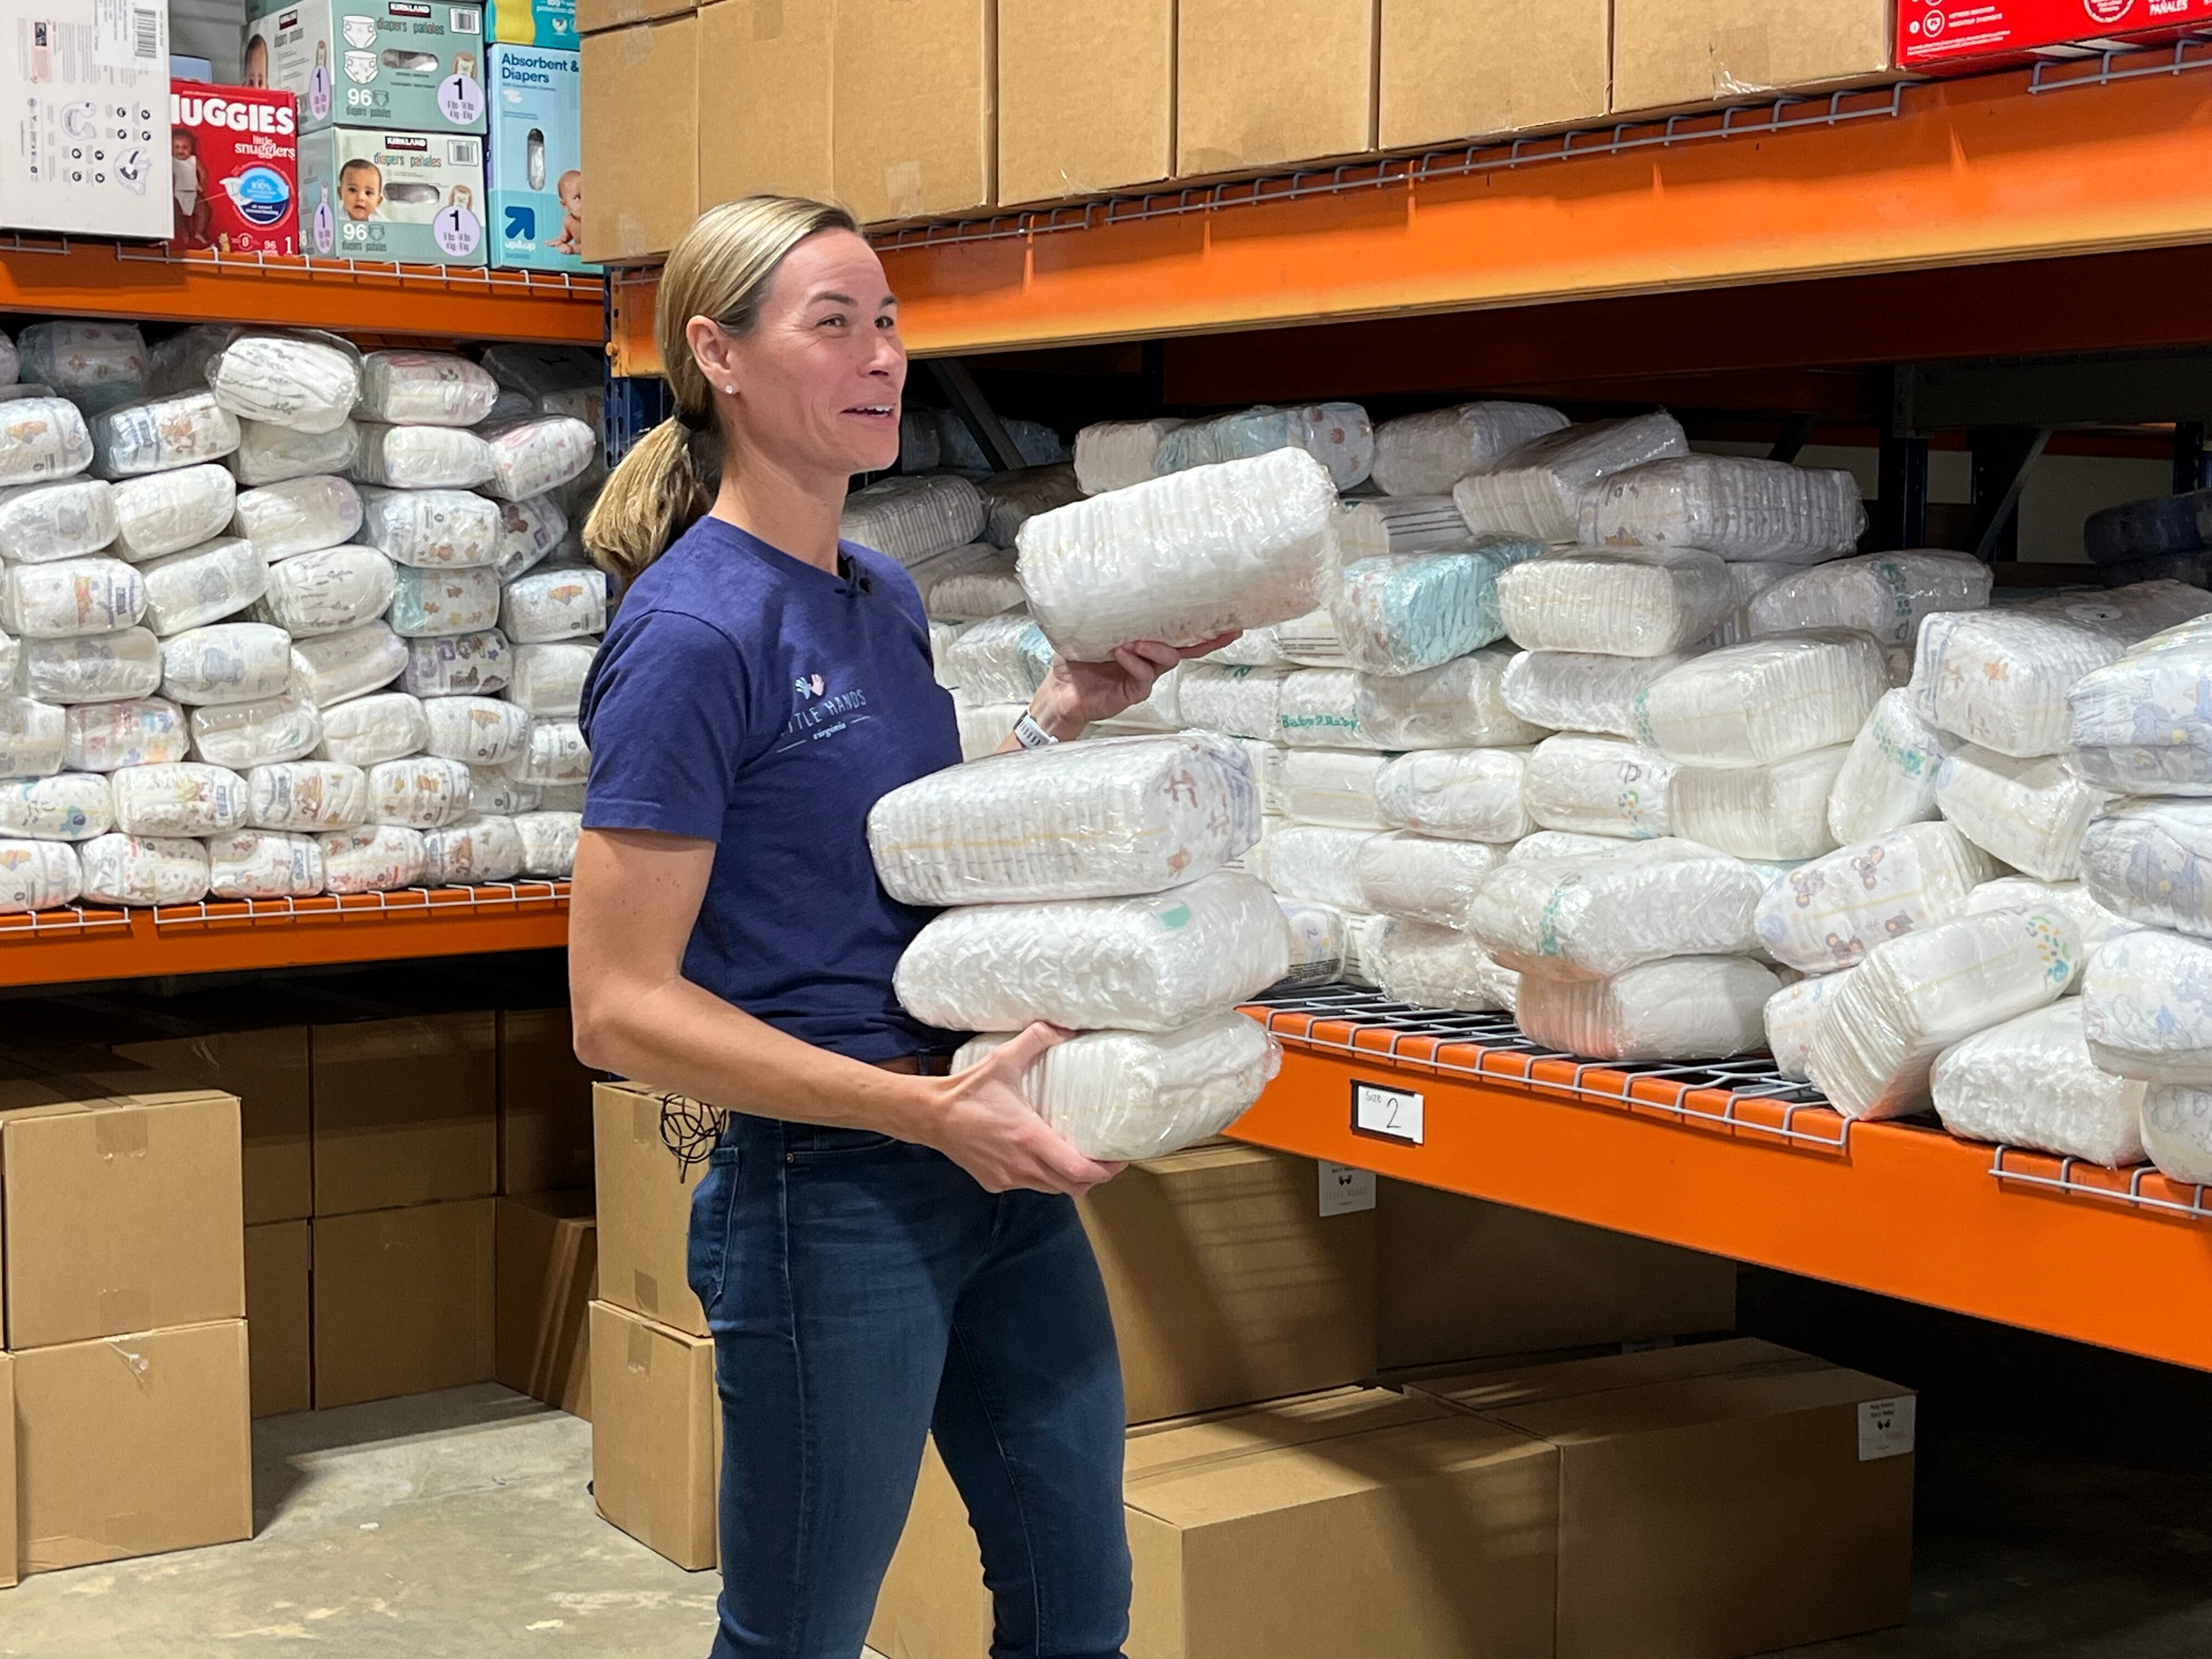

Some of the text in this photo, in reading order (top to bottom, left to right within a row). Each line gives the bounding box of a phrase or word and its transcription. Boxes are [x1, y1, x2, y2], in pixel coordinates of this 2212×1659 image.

[501, 53, 579, 72] Absorbent &
[502, 67, 550, 83] Diapers
[347, 88, 373, 106] 96
[453, 78, 463, 100] 1
[235, 143, 295, 159] snugglers
[449, 209, 459, 232] 1
[343, 223, 368, 241] 96
[285, 236, 293, 254] 1
[504, 240, 536, 252] up&up
[823, 689, 867, 715] HANDS
[1365, 1090, 1402, 1128] Size 2
